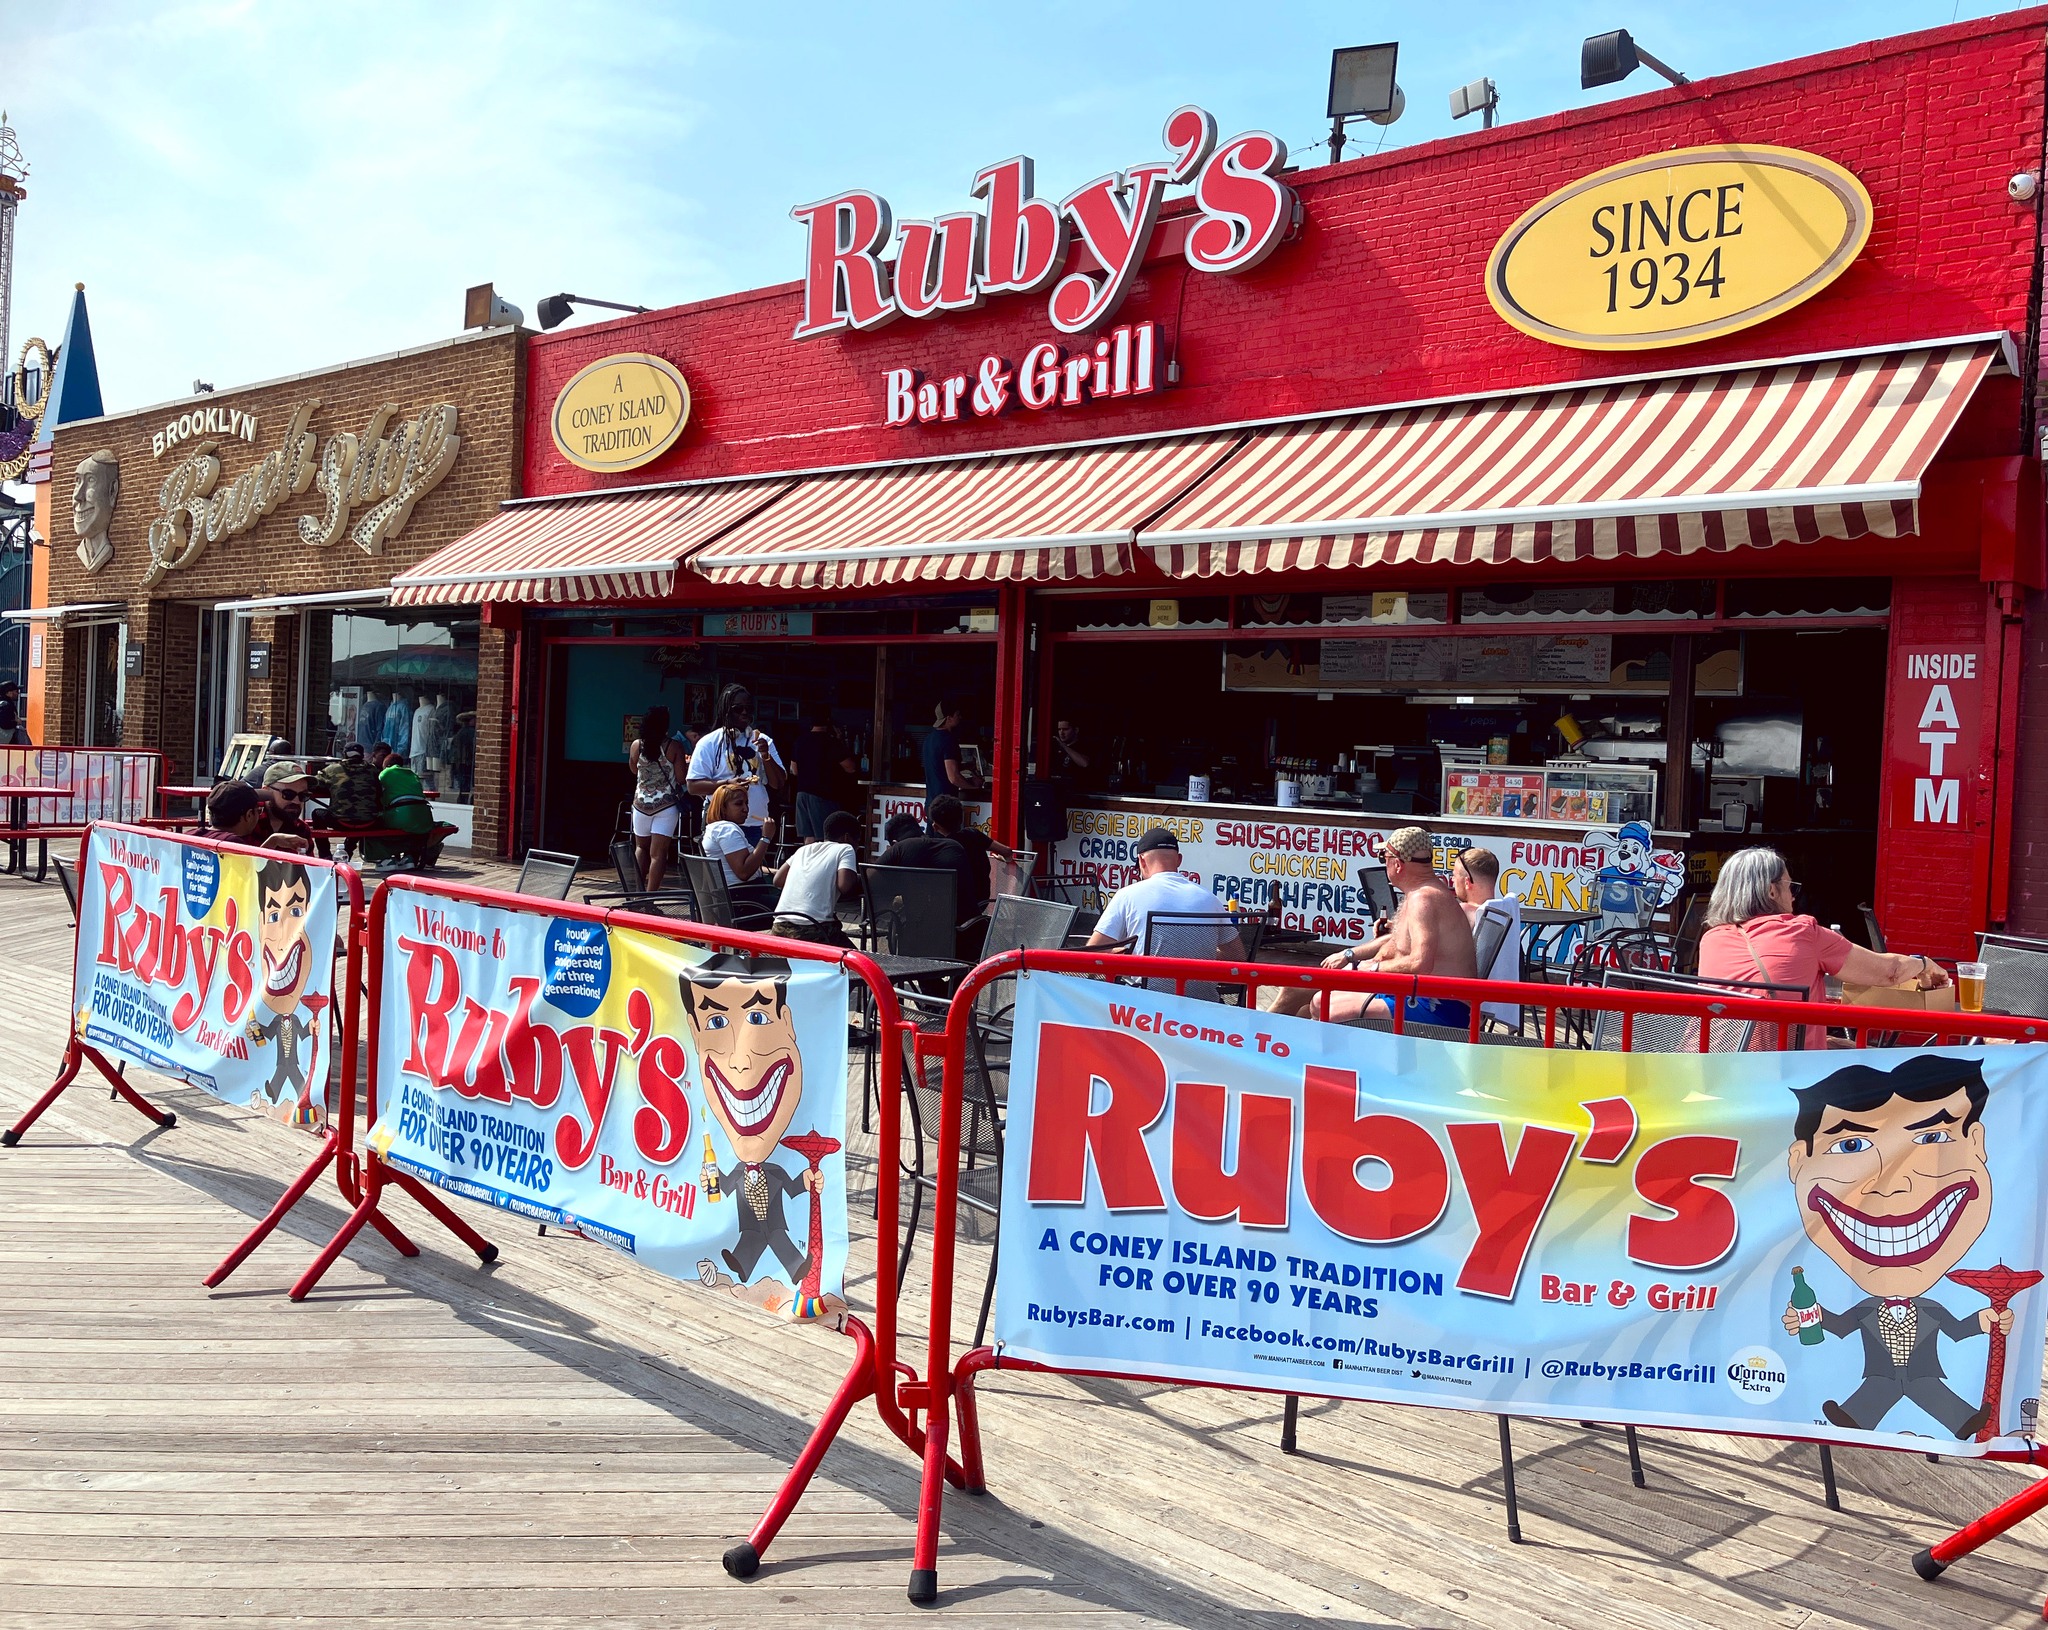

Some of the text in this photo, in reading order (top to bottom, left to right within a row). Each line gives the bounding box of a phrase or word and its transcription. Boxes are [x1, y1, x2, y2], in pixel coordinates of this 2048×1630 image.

[789, 104, 1286, 341] Ruby's
[1590, 182, 1744, 258] SINCE
[1603, 246, 1726, 313] 1934
[613, 374, 623, 394] A
[882, 321, 1157, 429] Bar & Grill
[572, 395, 666, 429] CONEY ISLAND
[152, 407, 258, 459] BROOKLYN
[583, 425, 652, 454] TRADITION
[138, 398, 461, 590] Beach Shop
[741, 614, 777, 630] RUBY'S
[1907, 654, 1976, 680] INSIDE
[1471, 717, 1497, 726] pepsi
[1913, 684, 1961, 824] ATM
[1190, 781, 1206, 789] TIPS
[1079, 837, 1128, 861] CRAB
[1215, 822, 1385, 859] SAUSAGE HERO
[1443, 836, 1472, 849] COLD
[1250, 852, 1347, 881] CHICKEN
[1302, 881, 1372, 916] FRIES
[413, 904, 506, 960] Welcome to
[1284, 911, 1366, 941] CLAMS
[96, 860, 254, 1033] Ruby's
[95, 972, 102, 988] A
[101, 975, 120, 996] CONEY
[120, 983, 143, 1007] ISLAND
[544, 983, 601, 1000] generations!
[567, 970, 595, 984] three
[92, 989, 112, 1019] FOR
[112, 999, 134, 1029] OVER
[135, 1009, 147, 1035] 80
[146, 1013, 174, 1050] YEARS
[1109, 1003, 1290, 1057] Welcome To
[195, 1018, 249, 1061] Bar & Grill
[397, 932, 692, 1172] Ruby's
[401, 1084, 546, 1154] A CONEY ISLAND TRADITION
[399, 1108, 554, 1193] FOR OVER 90 YEARS
[1026, 1020, 1742, 1302] Ruby's
[598, 1152, 698, 1221] Bar & Grill
[1038, 1228, 1443, 1297] A CONEY ISLAND TRADITION
[1099, 1264, 1379, 1319] FOR OVER 90 YEARS
[1540, 1274, 1719, 1312] Bar & Grill
[1799, 1308, 1819, 1324] Ruby's
[1027, 1303, 1717, 1385] RubysBar.com Facebook.com/RubysBarGrill @RubysBarGrill
[1253, 1353, 1326, 1368] WWW.MANHATTANBEER.COM
[1344, 1363, 1376, 1374] MANHATTAN
[1376, 1367, 1391, 1375] BEER
[1421, 1372, 1473, 1387] @MANHATTANBEER
[1727, 1363, 1786, 1384] Corona
[1741, 1379, 1772, 1393] Extra
